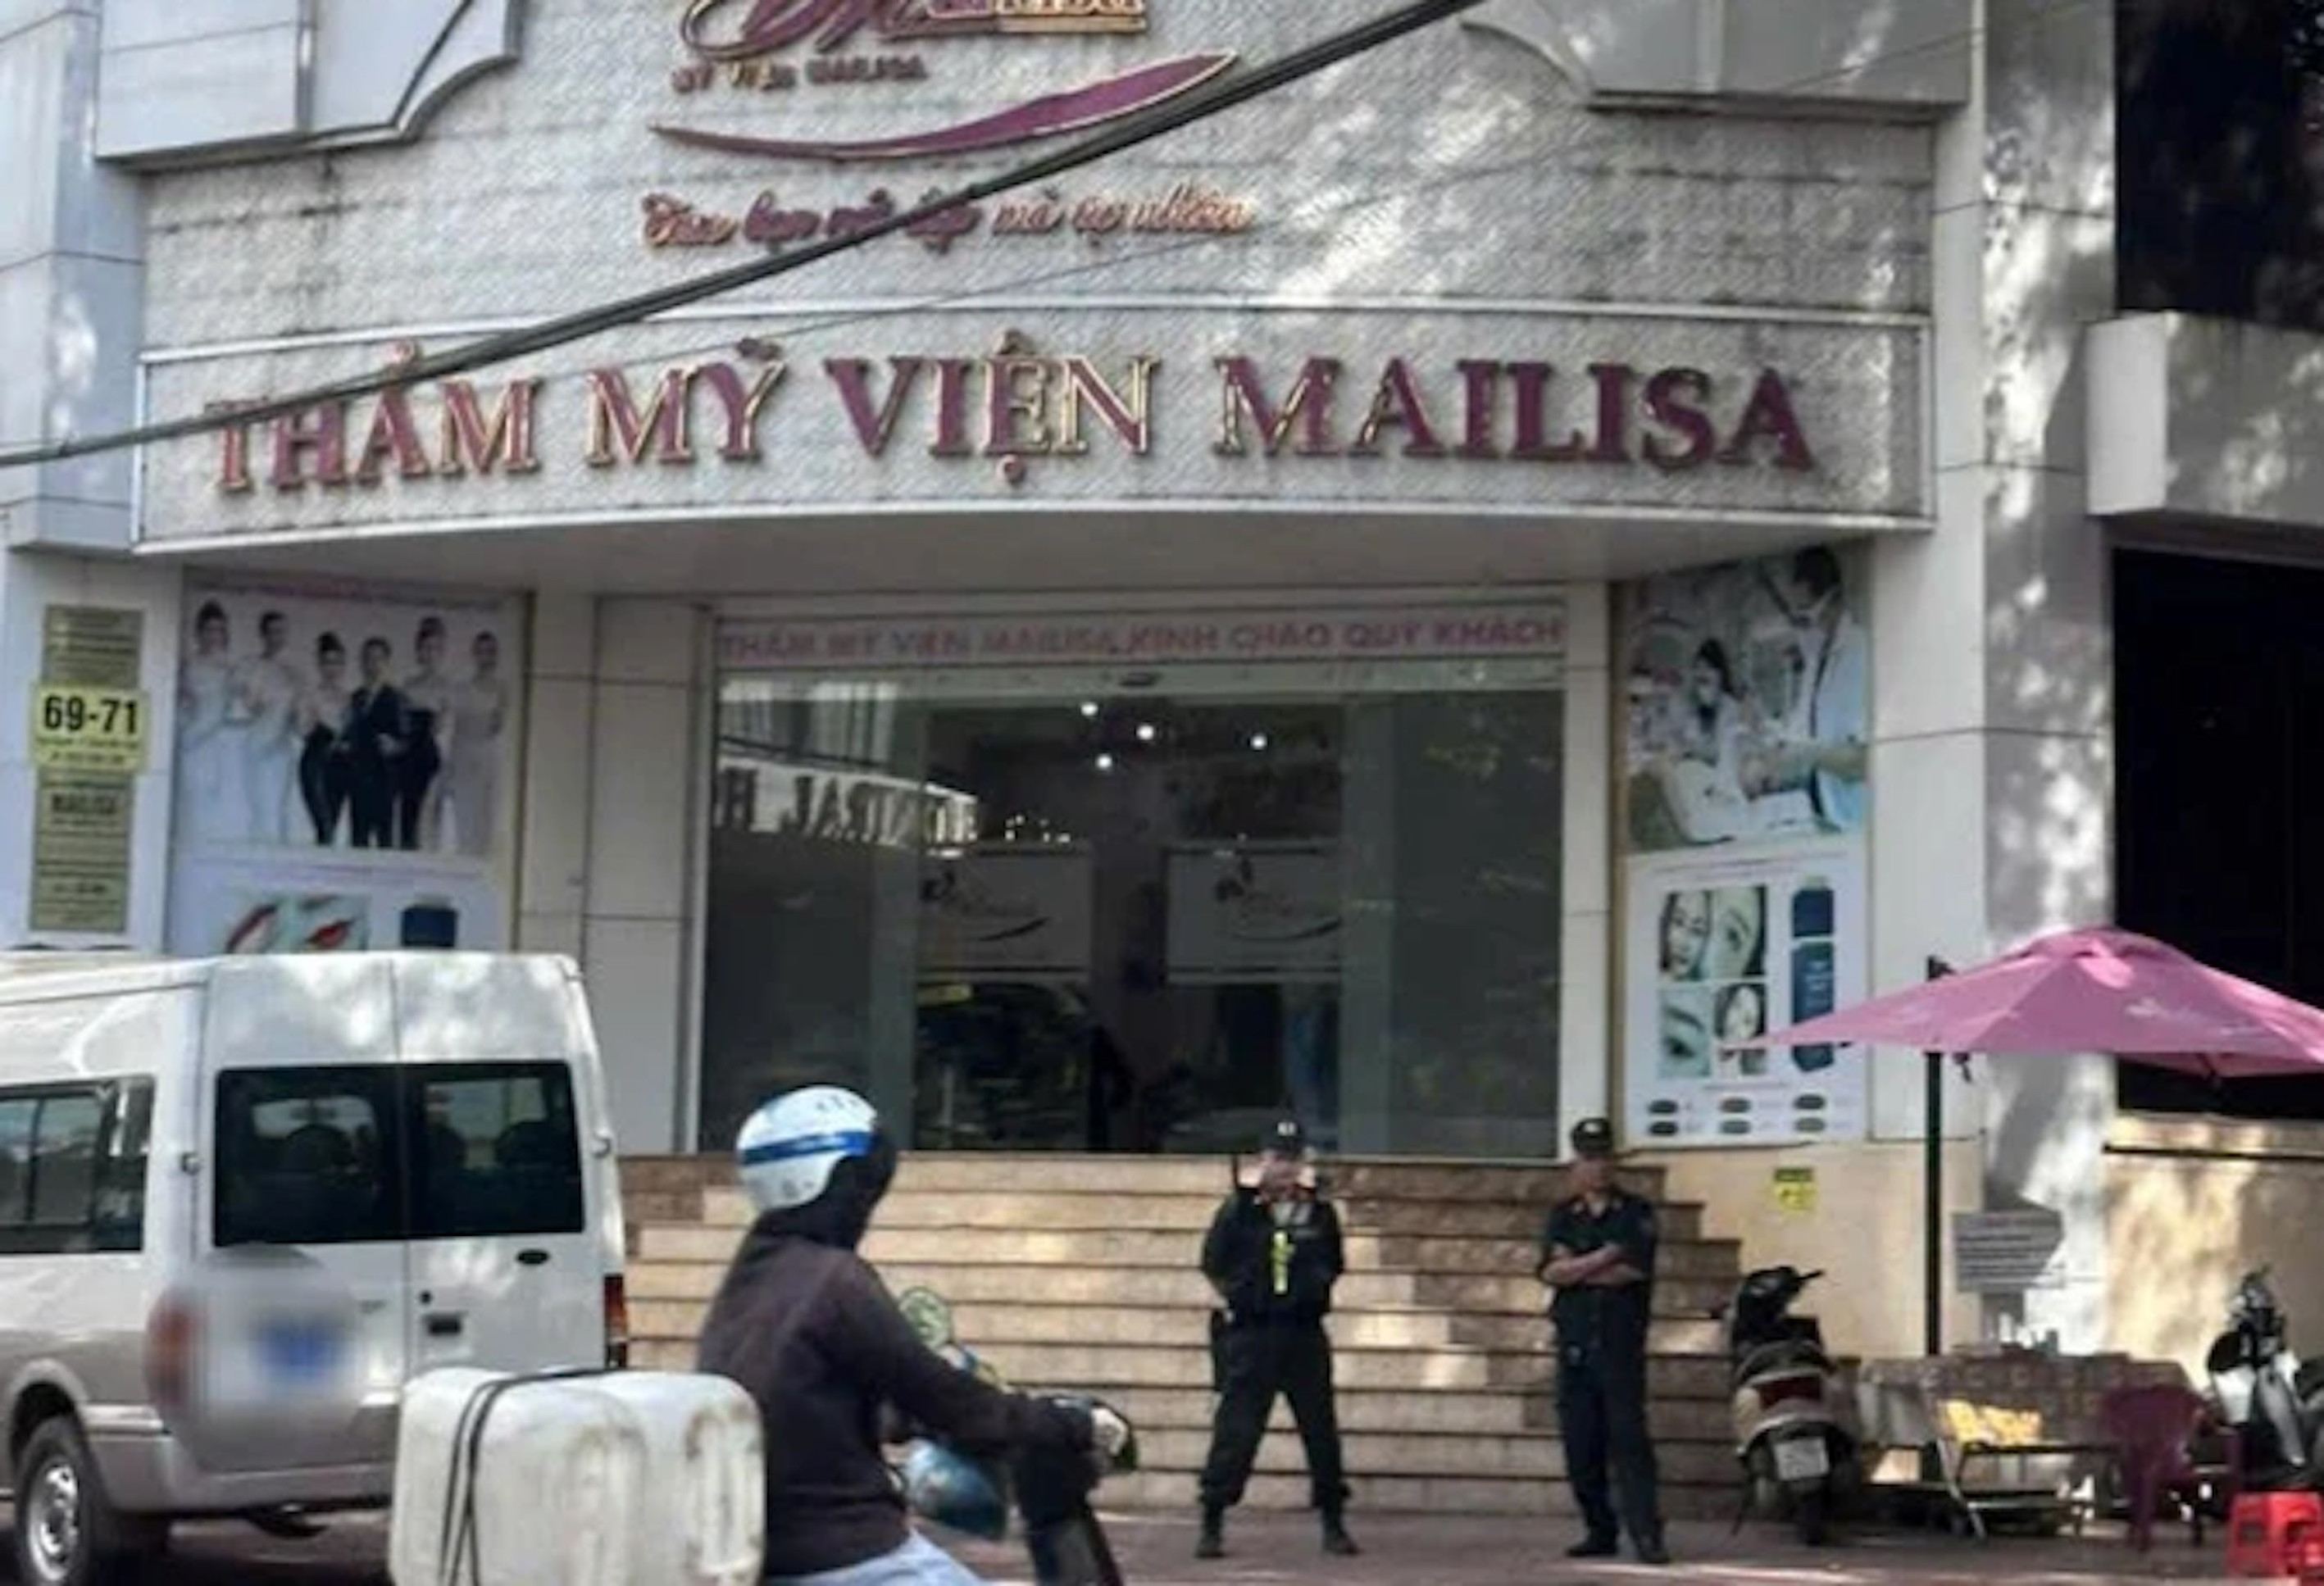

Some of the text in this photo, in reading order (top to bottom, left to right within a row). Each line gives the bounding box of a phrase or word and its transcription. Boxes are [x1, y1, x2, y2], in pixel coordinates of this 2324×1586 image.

[587, 337, 788, 467] MỸ
[823, 329, 1162, 485] VIỆN
[1213, 355, 1816, 477] MAILISA
[43, 695, 139, 735] 69-71
